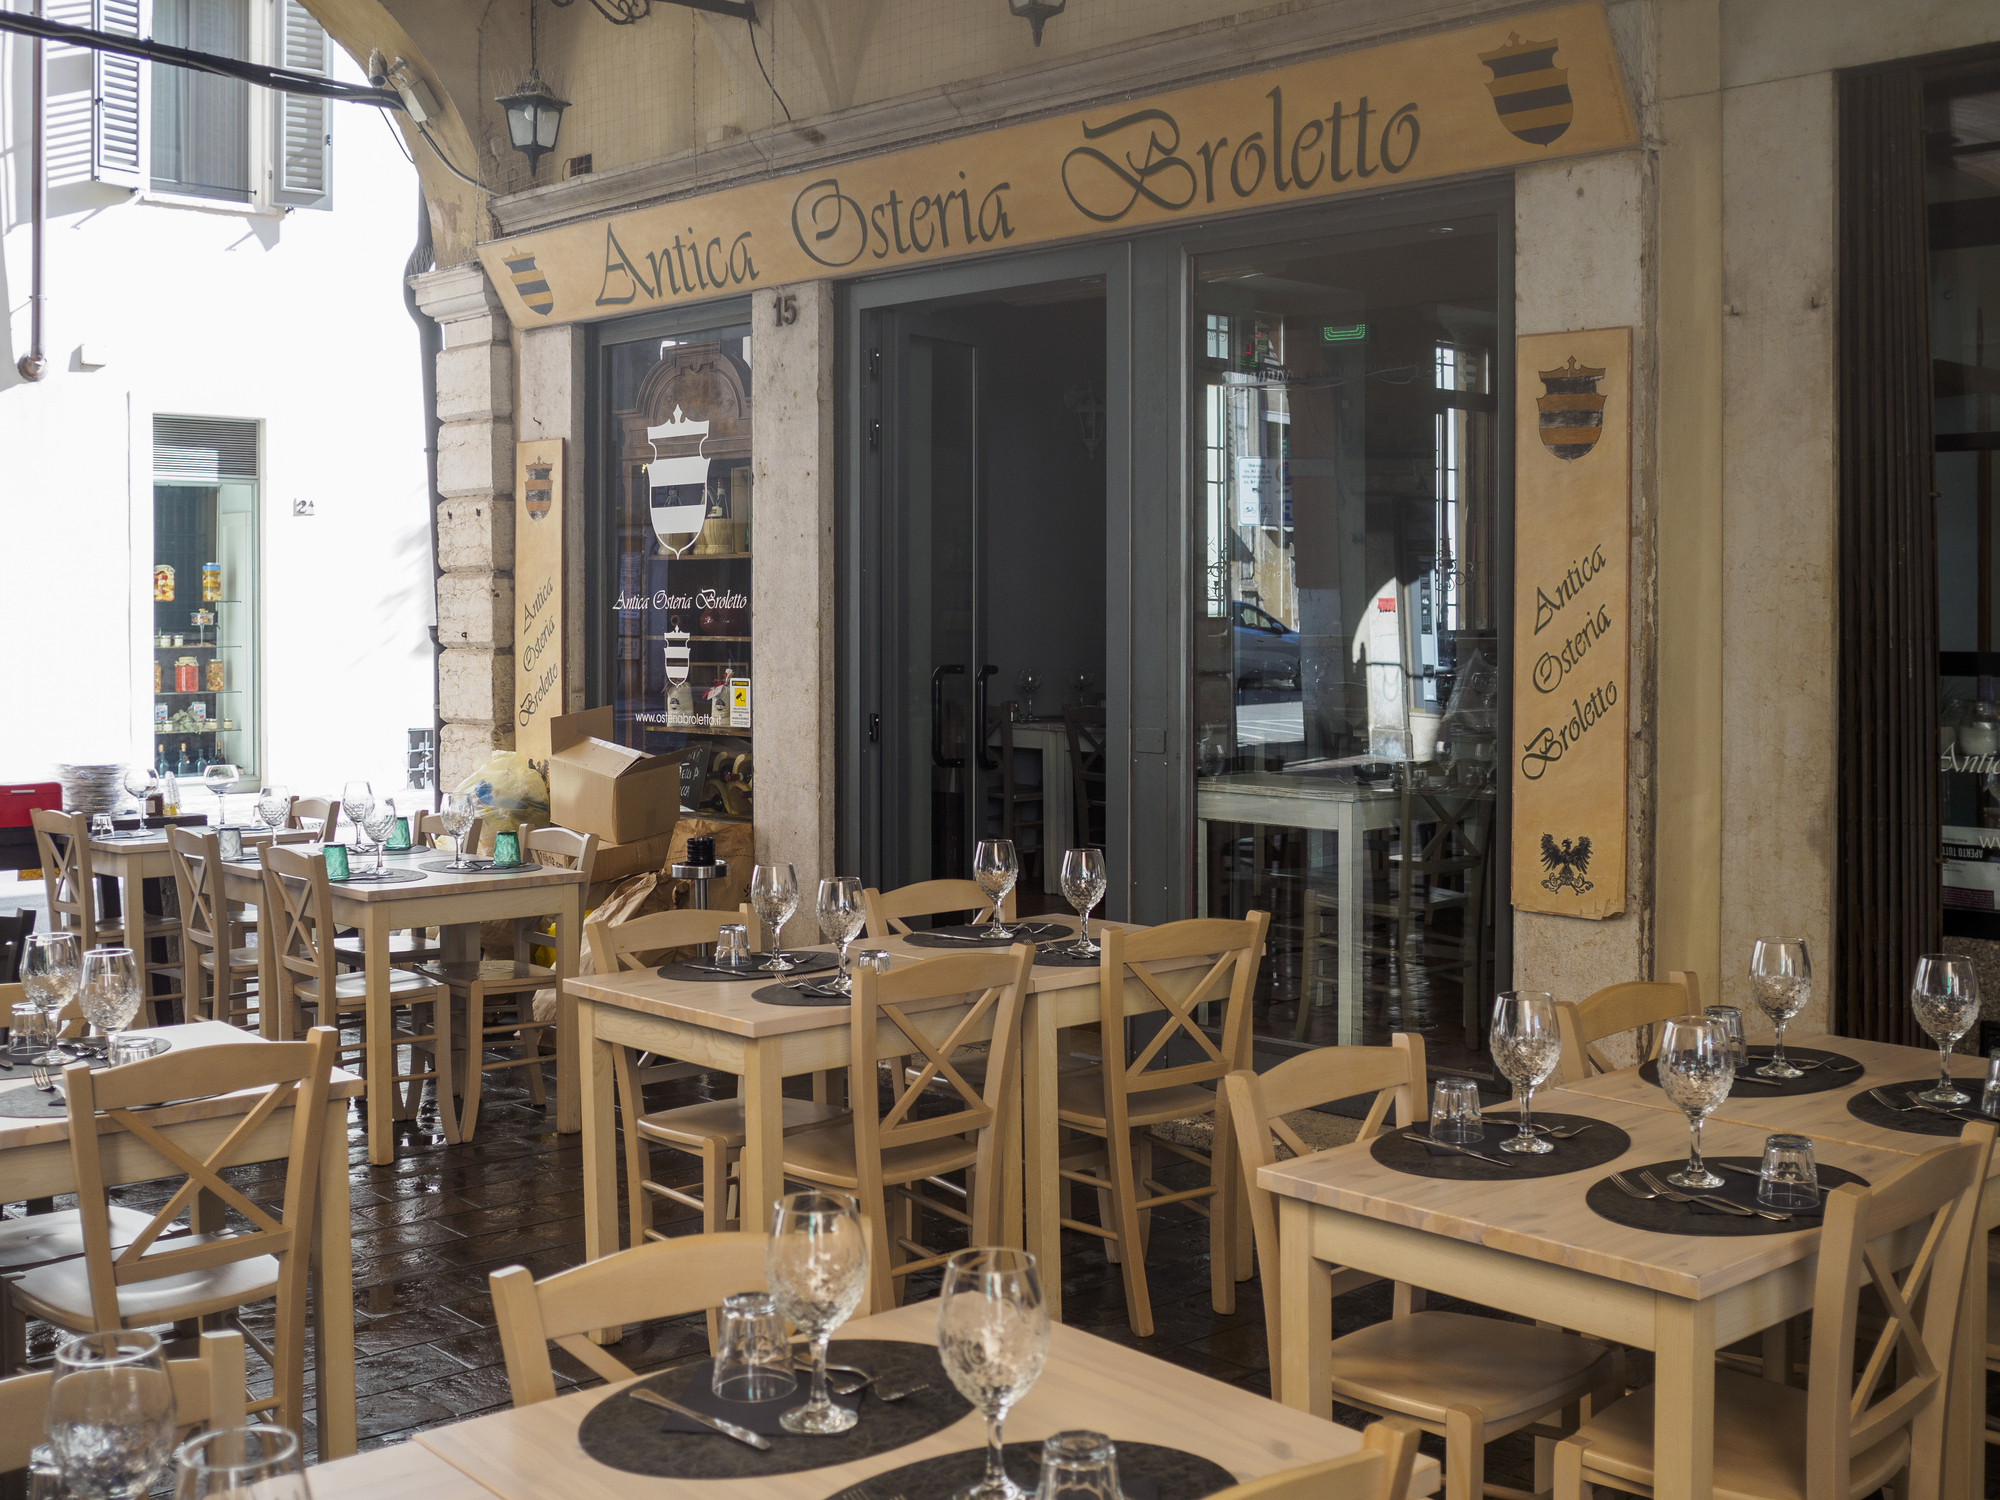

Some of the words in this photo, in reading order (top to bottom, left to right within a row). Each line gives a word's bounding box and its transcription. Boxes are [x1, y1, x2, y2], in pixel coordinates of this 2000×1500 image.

[595, 221, 759, 307] Antica
[791, 171, 1015, 267] Osteria
[1061, 84, 1421, 222] Broletto
[773, 295, 797, 327] 15
[523, 577, 554, 635] Antica
[612, 589, 650, 610] Antica
[652, 589, 693, 610] Osteria
[695, 588, 748, 610] Broletto
[1533, 543, 1607, 635] Antica
[522, 615, 556, 672] Osteria
[1532, 603, 1612, 695] Osteria
[518, 662, 558, 727] Broletto
[634, 711, 722, 727] www.osteriabroletto.it
[1521, 680, 1618, 781] Broletto
[1957, 848, 1984, 859] APERTO
